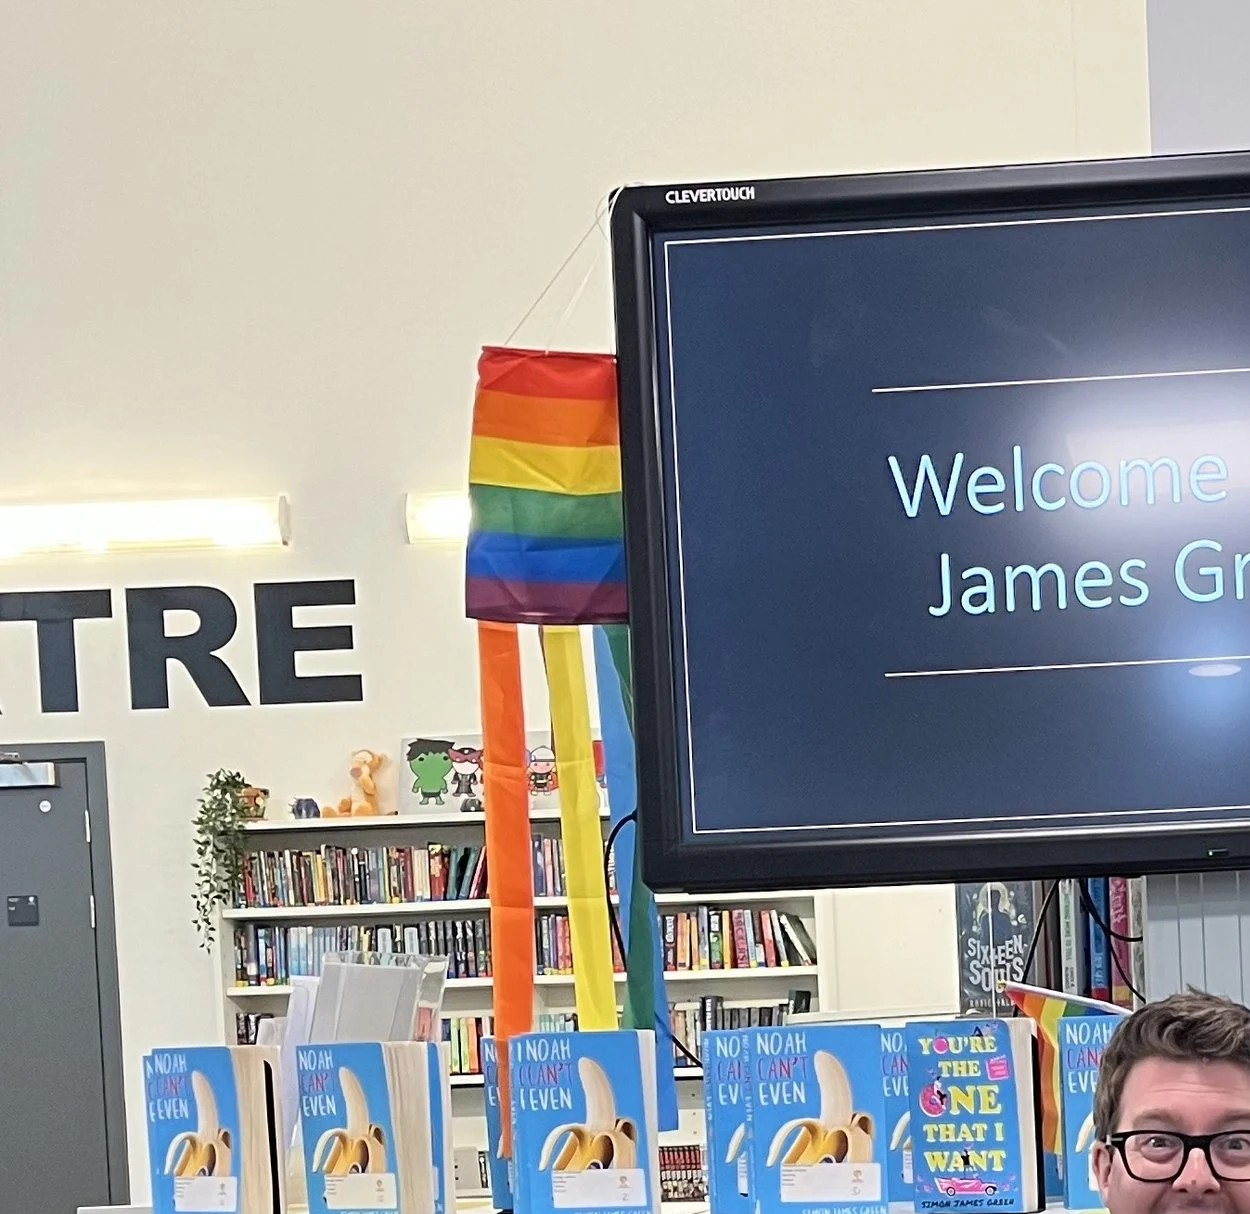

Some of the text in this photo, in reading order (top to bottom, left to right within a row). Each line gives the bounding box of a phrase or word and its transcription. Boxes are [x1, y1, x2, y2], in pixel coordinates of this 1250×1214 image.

[665, 186, 755, 204] CLEVERTOUCH
[888, 445, 1228, 518] Welcome
[928, 552, 1149, 617] James
[0, 579, 363, 714] TRE
[756, 1031, 807, 1056] NOAH
[918, 1035, 998, 1055] YOU'RE
[1065, 1022, 1113, 1046] NOAH
[525, 1038, 571, 1062] NOAH
[716, 1036, 740, 1057] NO
[154, 1053, 188, 1075] NOAH
[298, 1050, 334, 1071] NOAH
[758, 1056, 808, 1081] CAN'T
[938, 1060, 981, 1078] THE
[883, 1075, 909, 1097] EVE
[1068, 1070, 1097, 1093] EVE
[529, 1087, 573, 1111] EVEN
[759, 1081, 806, 1106] EVEN
[157, 1098, 189, 1120] EVEN
[302, 1095, 337, 1117] EVEN
[923, 1122, 1005, 1142] THAT I
[924, 1150, 1007, 1172] WANT
[921, 1198, 1015, 1209] SIMON JAMES GREEN
